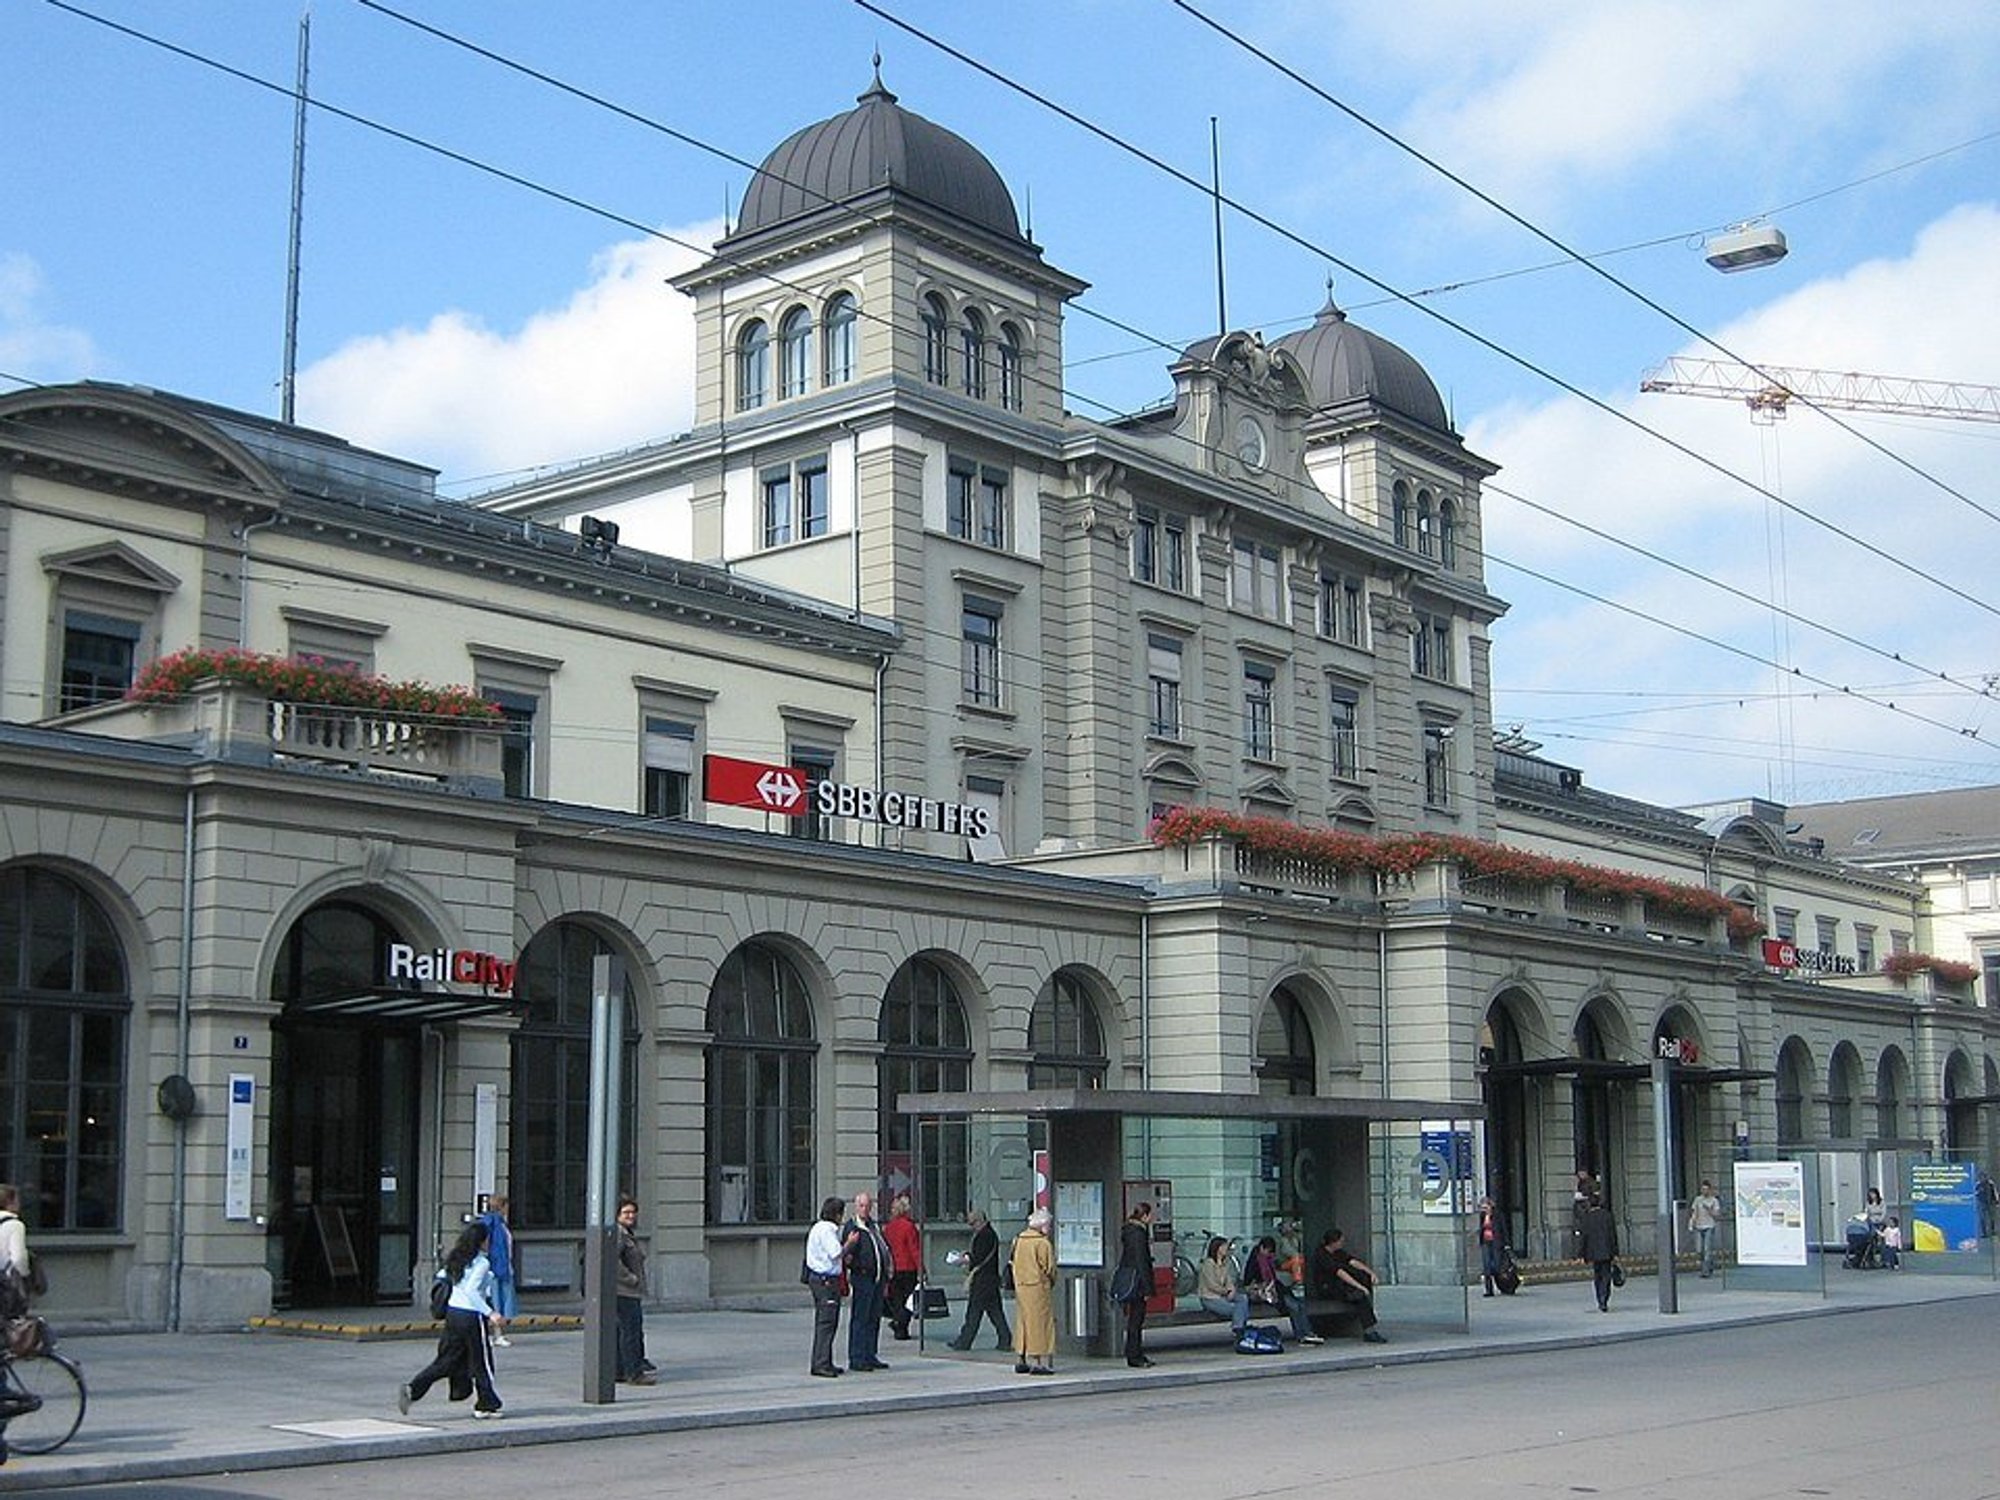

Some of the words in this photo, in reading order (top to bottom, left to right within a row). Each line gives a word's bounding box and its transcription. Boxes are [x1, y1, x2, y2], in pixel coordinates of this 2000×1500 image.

[817, 779, 877, 820] SBB
[883, 791, 938, 830] CFF
[943, 801, 991, 838] FFS
